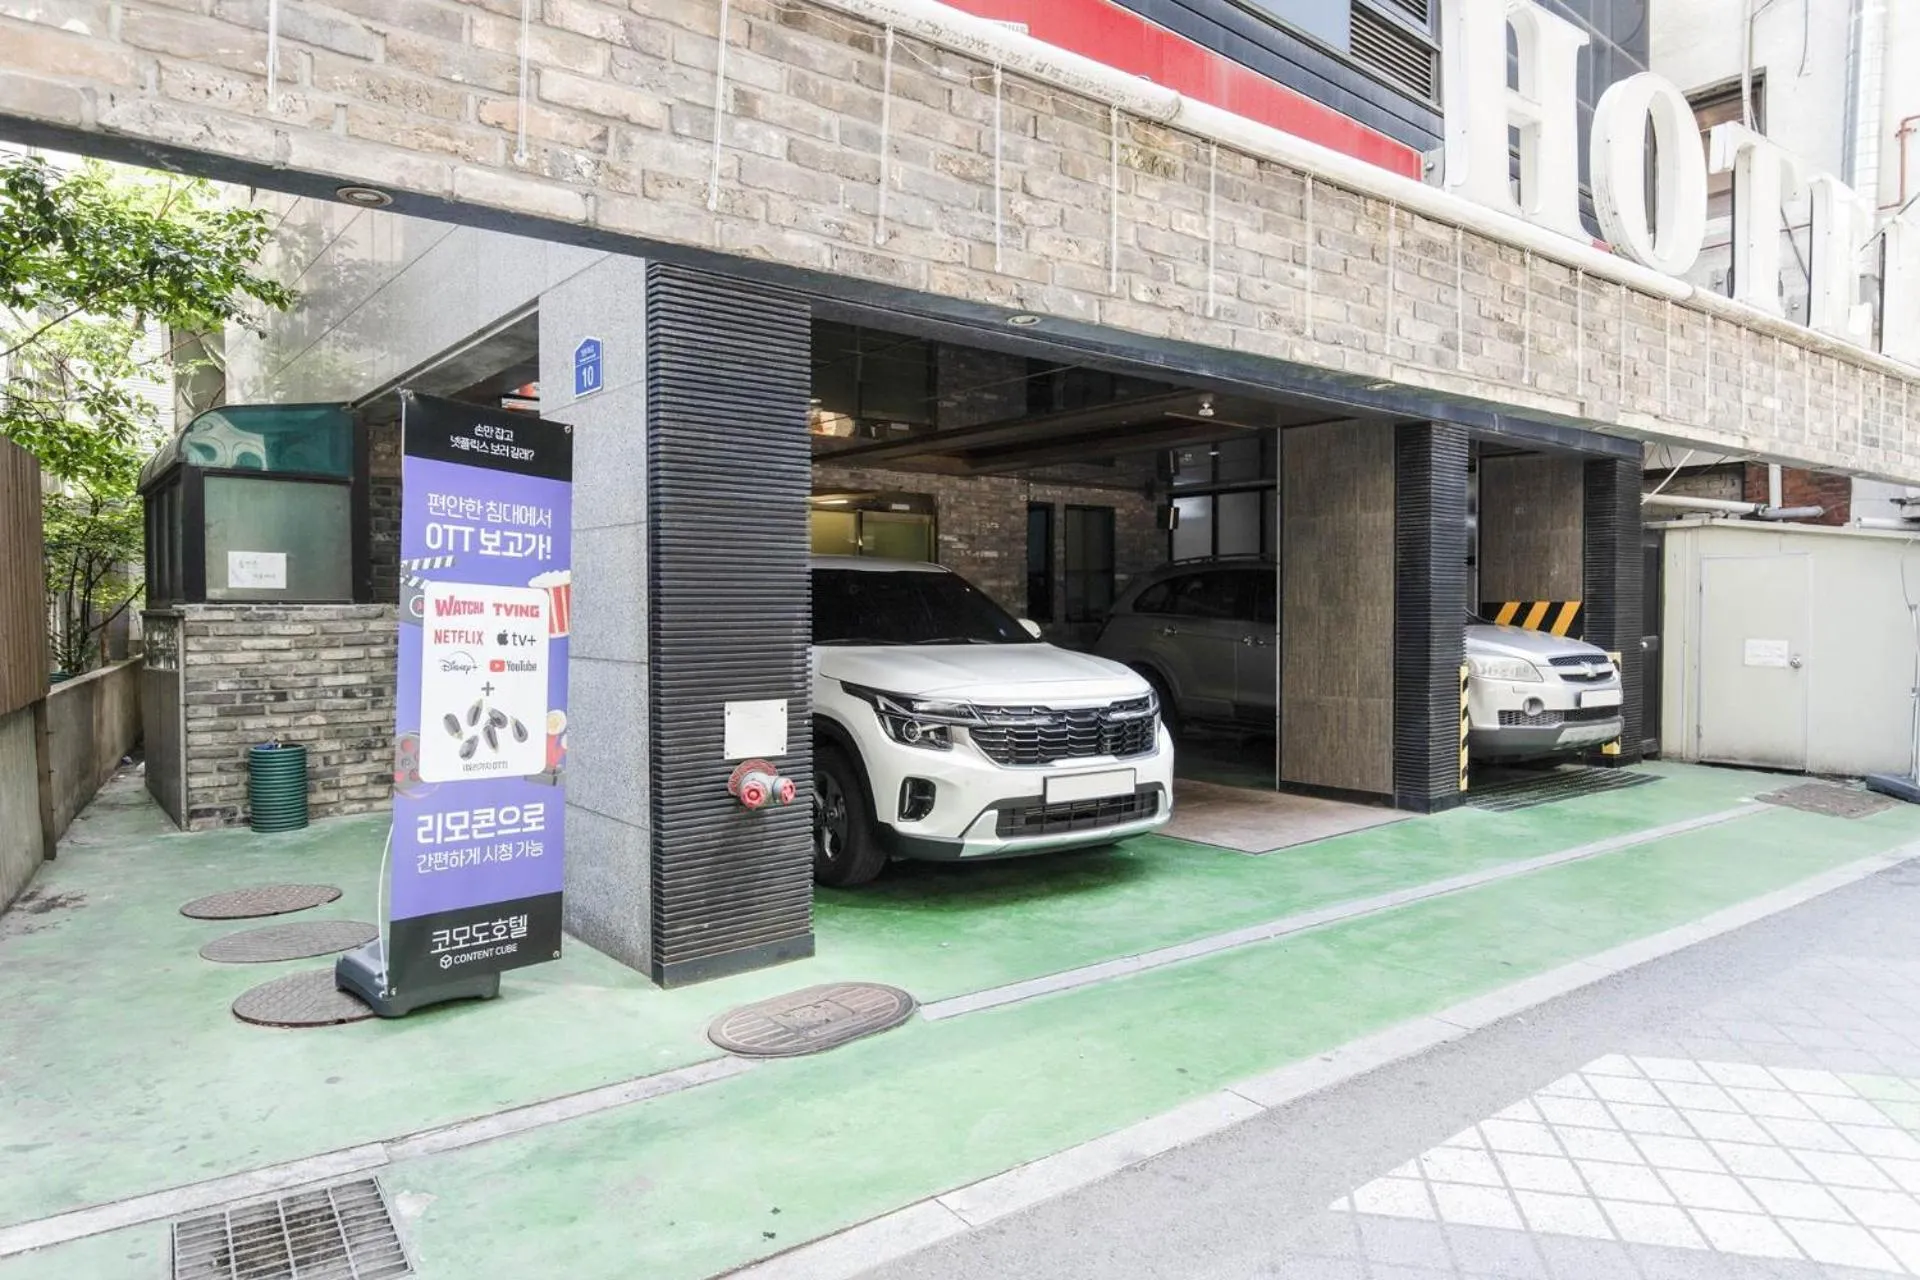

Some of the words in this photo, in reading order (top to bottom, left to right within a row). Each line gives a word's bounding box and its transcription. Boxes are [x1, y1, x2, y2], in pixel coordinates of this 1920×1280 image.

[582, 366, 593, 388] 10
[474, 424, 494, 438] 손만
[495, 427, 514, 442] 잡고
[450, 435, 489, 453] 넷플릭스
[490, 443, 509, 457] 보러
[510, 446, 535, 461] 갈래?
[427, 493, 483, 520] 편안한
[486, 500, 552, 528] 침대에서
[425, 522, 475, 552] OTT
[479, 528, 552, 561] 보고가!
[435, 594, 484, 617] WATCHA
[492, 602, 540, 618] TVING
[434, 629, 484, 645] NETFLIX
[506, 660, 537, 672] YouTube
[416, 802, 545, 844] 리모콘으로
[416, 846, 480, 874] 간편하게
[483, 841, 513, 864] 시청
[515, 839, 544, 859] 가능
[430, 914, 528, 954] 코모도호텔
[454, 949, 494, 965] CONTENT
[495, 943, 518, 956] CUBE
